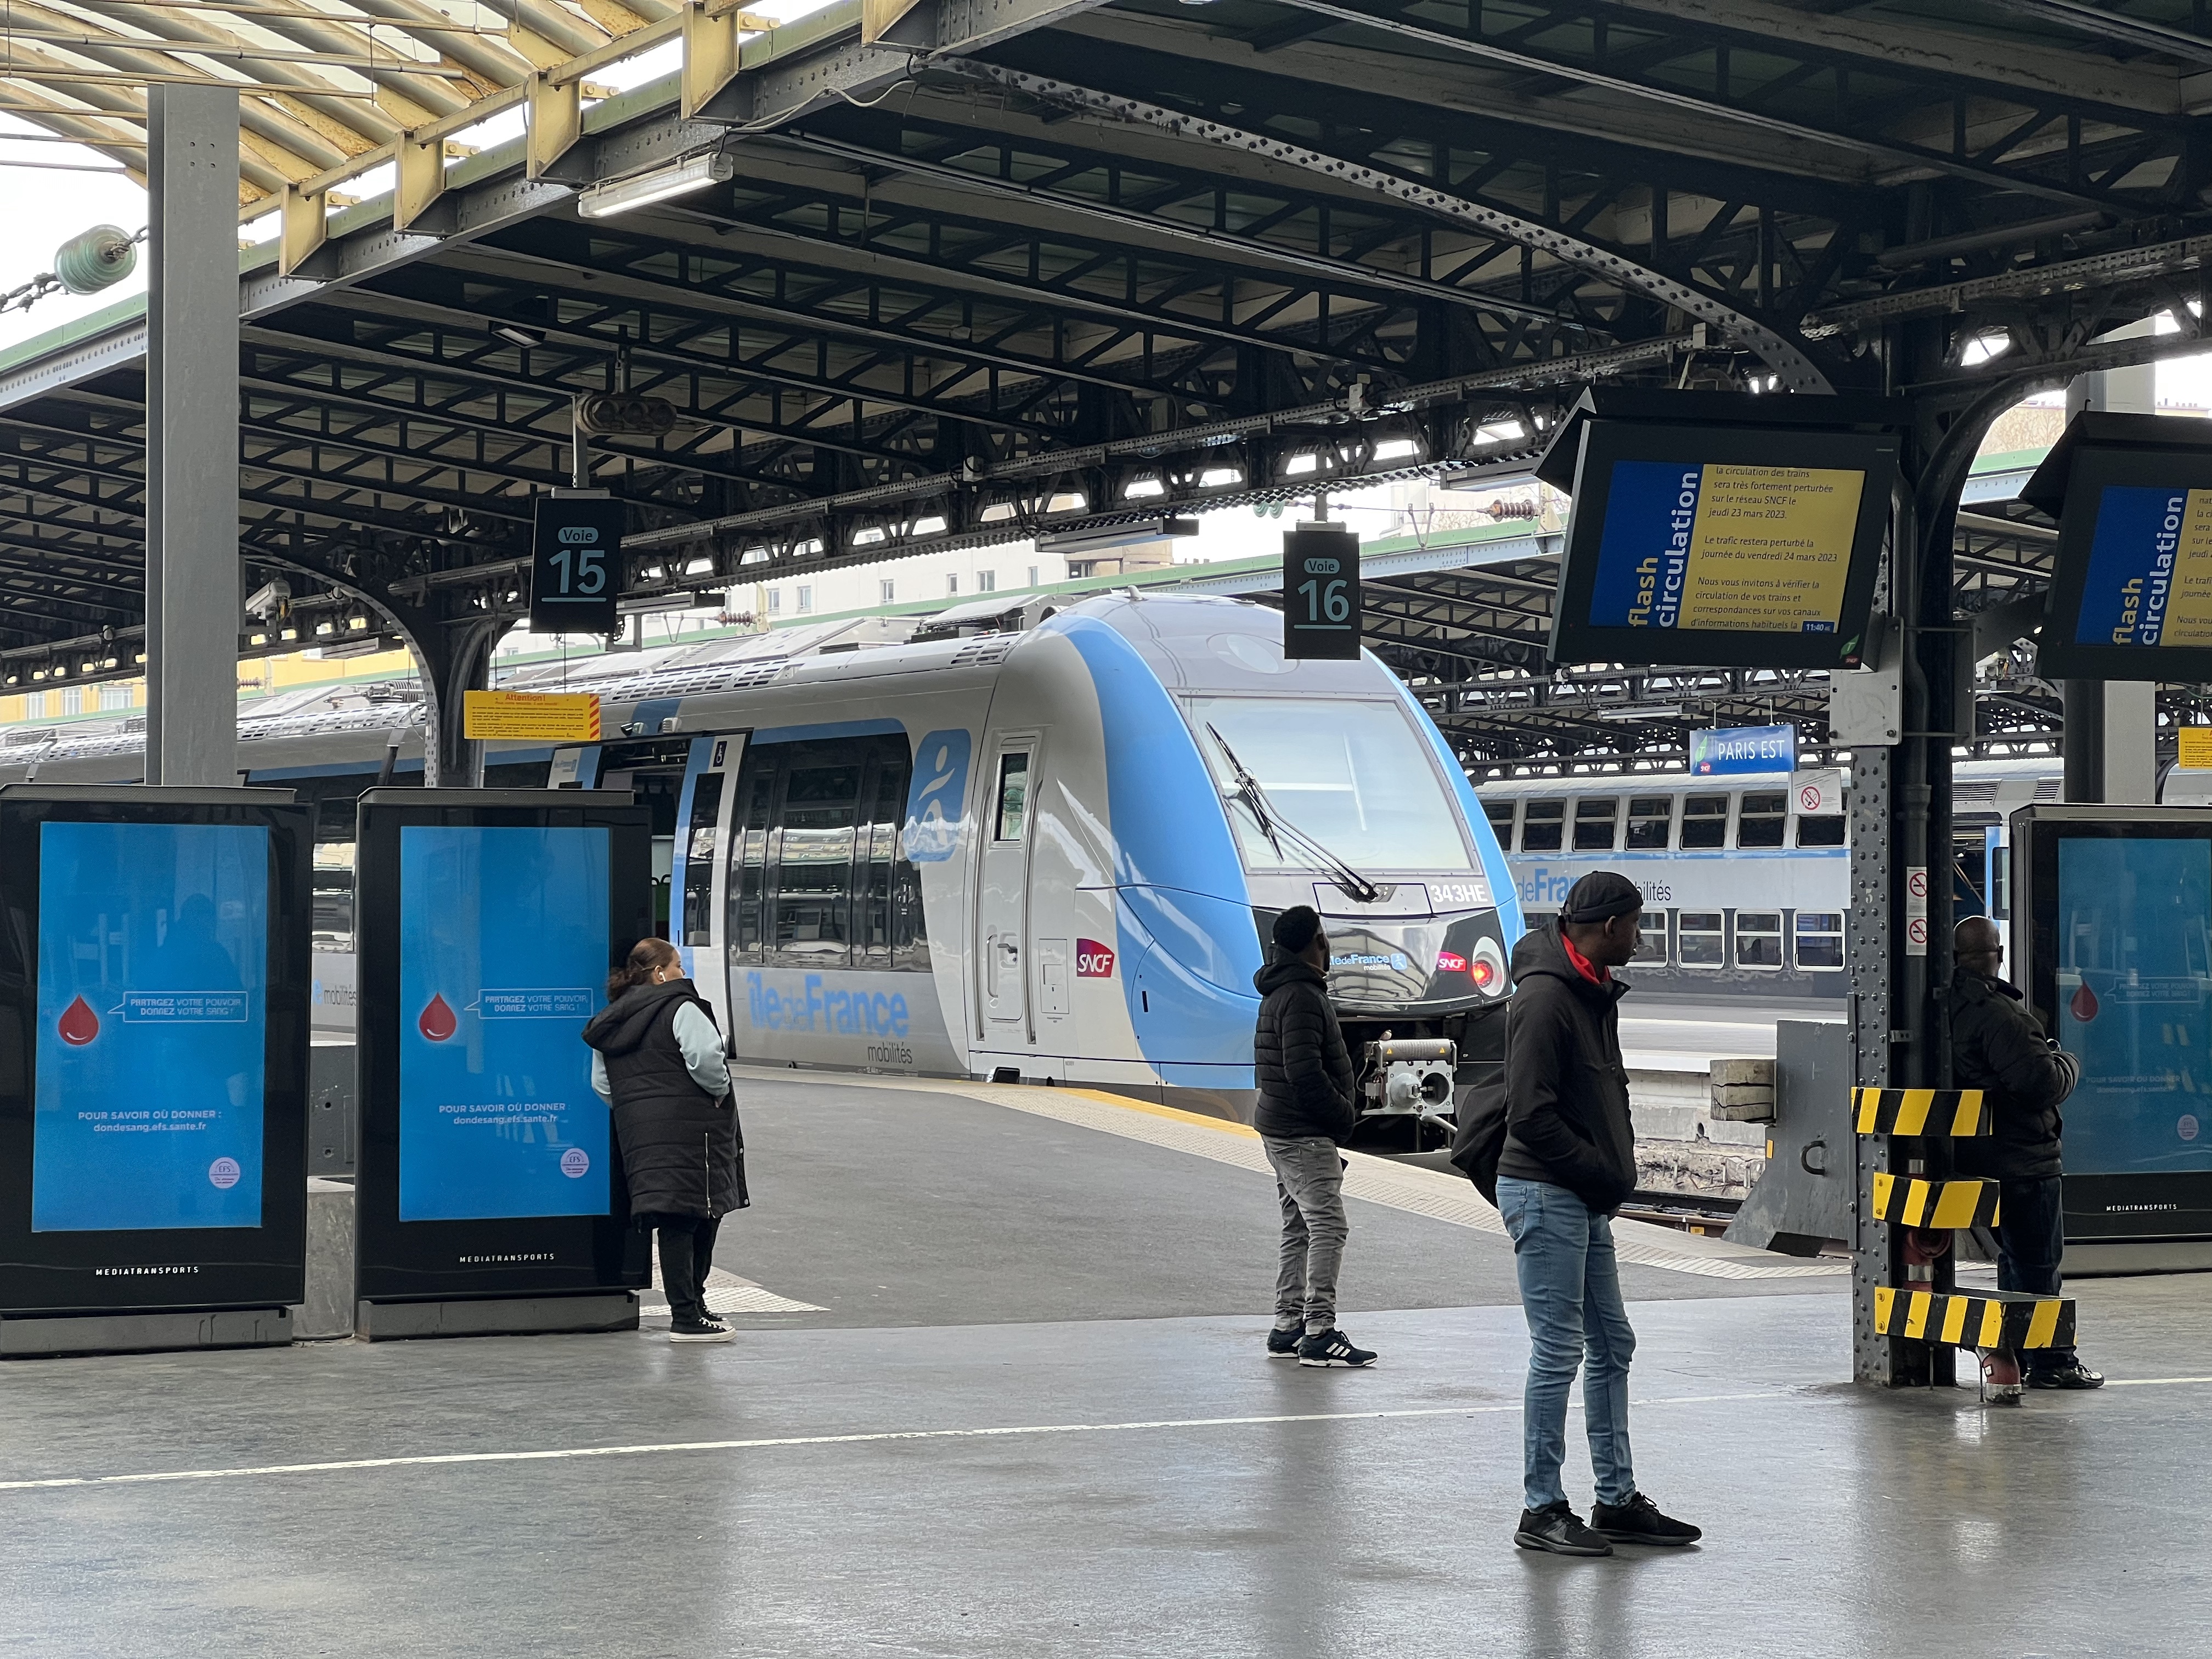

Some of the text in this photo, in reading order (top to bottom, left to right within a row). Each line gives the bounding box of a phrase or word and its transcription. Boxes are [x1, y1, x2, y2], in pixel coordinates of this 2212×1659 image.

[1716, 466, 1810, 478] la circulation des trains
[1733, 481, 1748, 490] très
[1751, 482, 1792, 492] fortement
[1793, 483, 1833, 494] perturbée
[1726, 494, 1734, 503] le
[1736, 495, 1762, 504] réseau
[1764, 495, 1788, 505] SNCF
[1788, 496, 1797, 506] le
[1707, 508, 1729, 518] jeudi
[1731, 508, 1742, 517] 23
[563, 529, 593, 542] Voie
[1705, 535, 1814, 548] Le trafic restera perturbé la
[1655, 472, 1698, 627] circulation
[1701, 549, 1733, 560] journée
[1735, 550, 1746, 559] du
[1747, 551, 1783, 561] vendredi
[1784, 552, 1795, 561] 24
[1818, 553, 1837, 562] 2023
[2187, 550, 2209, 560] jeudi
[549, 550, 605, 594] 15
[1308, 560, 1335, 572] Voie
[2139, 496, 2183, 645] circulation
[1698, 577, 1719, 586] Nous
[1741, 578, 1774, 588] invitons
[1775, 579, 1780, 588] à
[1782, 579, 1810, 589] vérifier
[1812, 580, 1820, 589] la
[2184, 575, 2194, 584] Le
[1628, 557, 1658, 627] flash
[1695, 591, 1739, 601] circulation
[1740, 592, 1751, 601] de
[1768, 593, 1791, 602] trains
[2180, 589, 2211, 599] journée
[1297, 579, 1350, 622] 16
[1693, 606, 1761, 616] correspondances
[1793, 608, 1821, 617] canaux
[2112, 578, 2143, 645] flash
[1691, 618, 1749, 629] d'informations
[1751, 620, 1788, 630] habituels
[1791, 621, 1798, 630] la
[2176, 615, 2197, 624] Nous
[1718, 740, 1785, 760] PARIS EST
[1430, 884, 1488, 903] 343HE
[1634, 879, 1671, 901] bilités
[1865, 888, 1873, 904] 5
[1077, 953, 1112, 973] SNCF
[1329, 953, 1390, 966] ledeFrance
[1438, 958, 1464, 969] SNCF
[177, 1007, 204, 1015] VOTRE
[527, 1003, 552, 1012] VOTRE
[867, 1041, 913, 1064] mobilités
[439, 1104, 467, 1113] POUR
[469, 1104, 505, 1113] SAVOIR
[507, 1102, 522, 1111] OÙ
[524, 1103, 566, 1111] DONNER
[78, 1111, 108, 1120] POUR
[111, 1111, 150, 1120] SAVOIR
[153, 1109, 168, 1119] OÙ
[171, 1110, 216, 1119] DONNER
[460, 1253, 555, 1263] MEDIATRANSPORTS
[95, 1266, 199, 1276] MEDIATRANSPORTS
